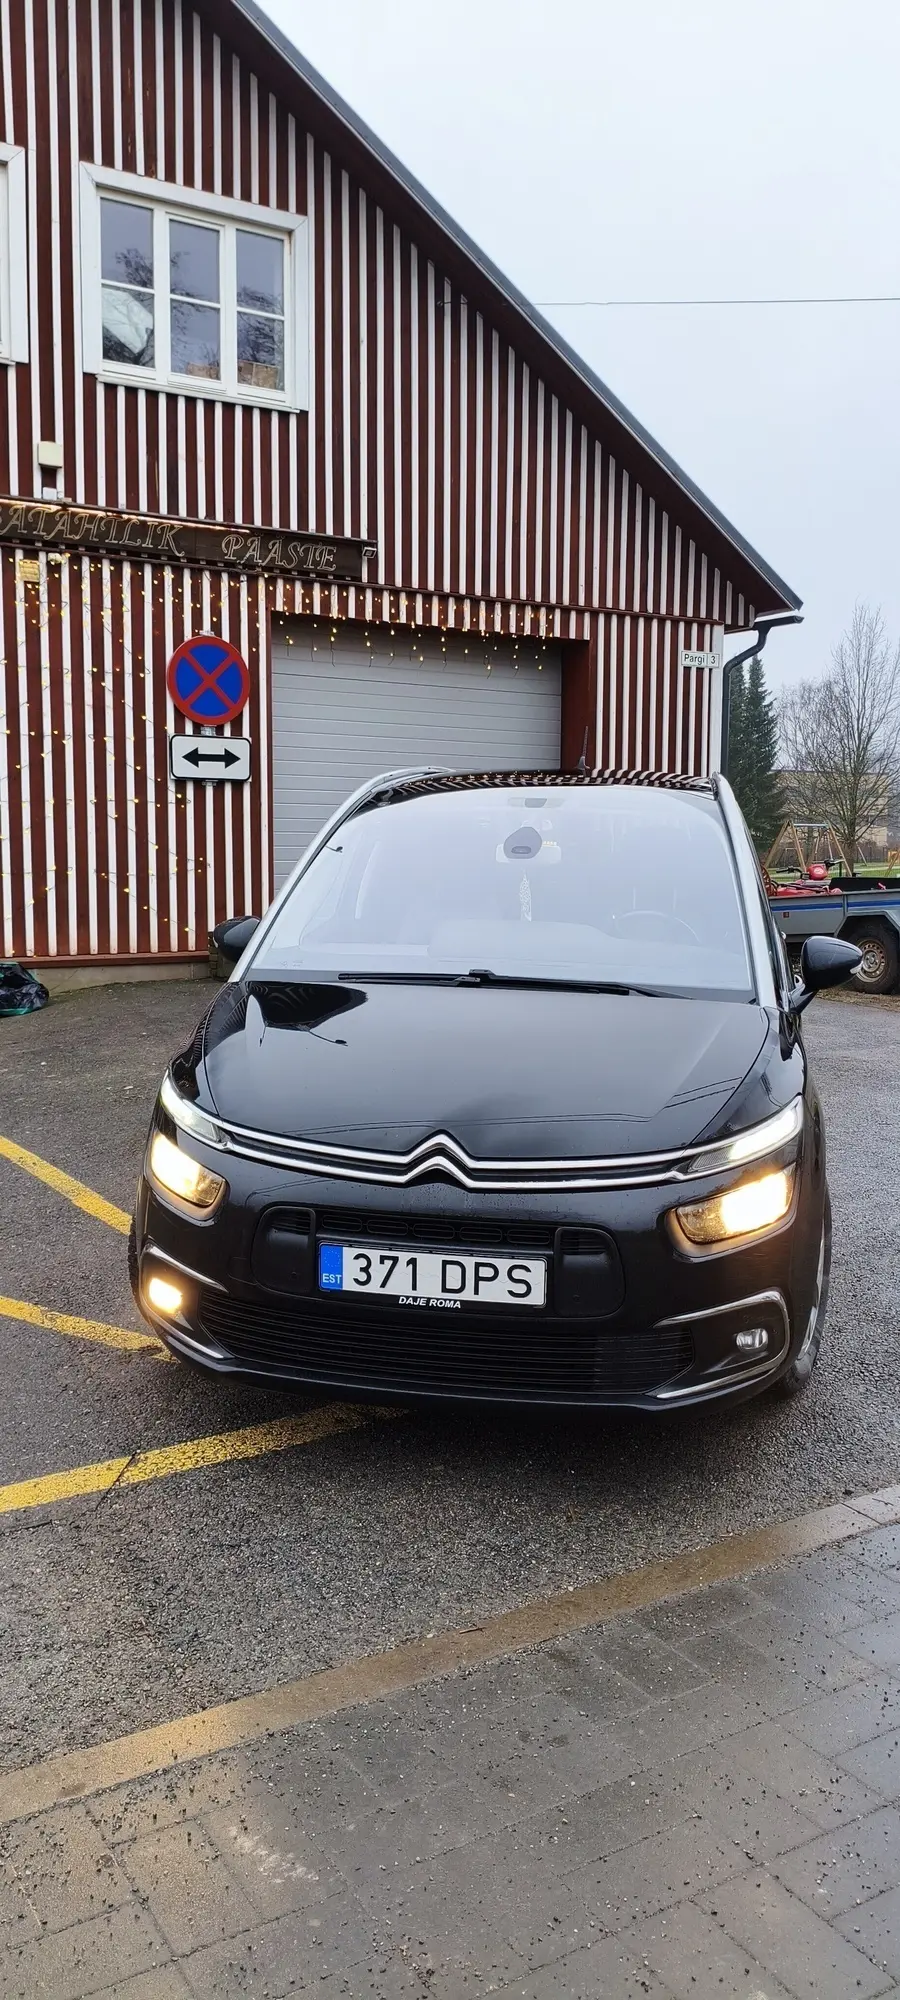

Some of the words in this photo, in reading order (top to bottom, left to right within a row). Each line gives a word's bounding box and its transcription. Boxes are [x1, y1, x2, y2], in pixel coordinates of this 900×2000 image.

[0, 504, 185, 557] ATAHTLIK
[684, 653, 706, 666] Pargi
[710, 655, 716, 665] 3
[322, 1273, 342, 1285] EST
[352, 1252, 418, 1292] 371
[441, 1259, 532, 1299] DPS
[398, 1296, 427, 1307] DAJE
[429, 1298, 462, 1309] ROMA
